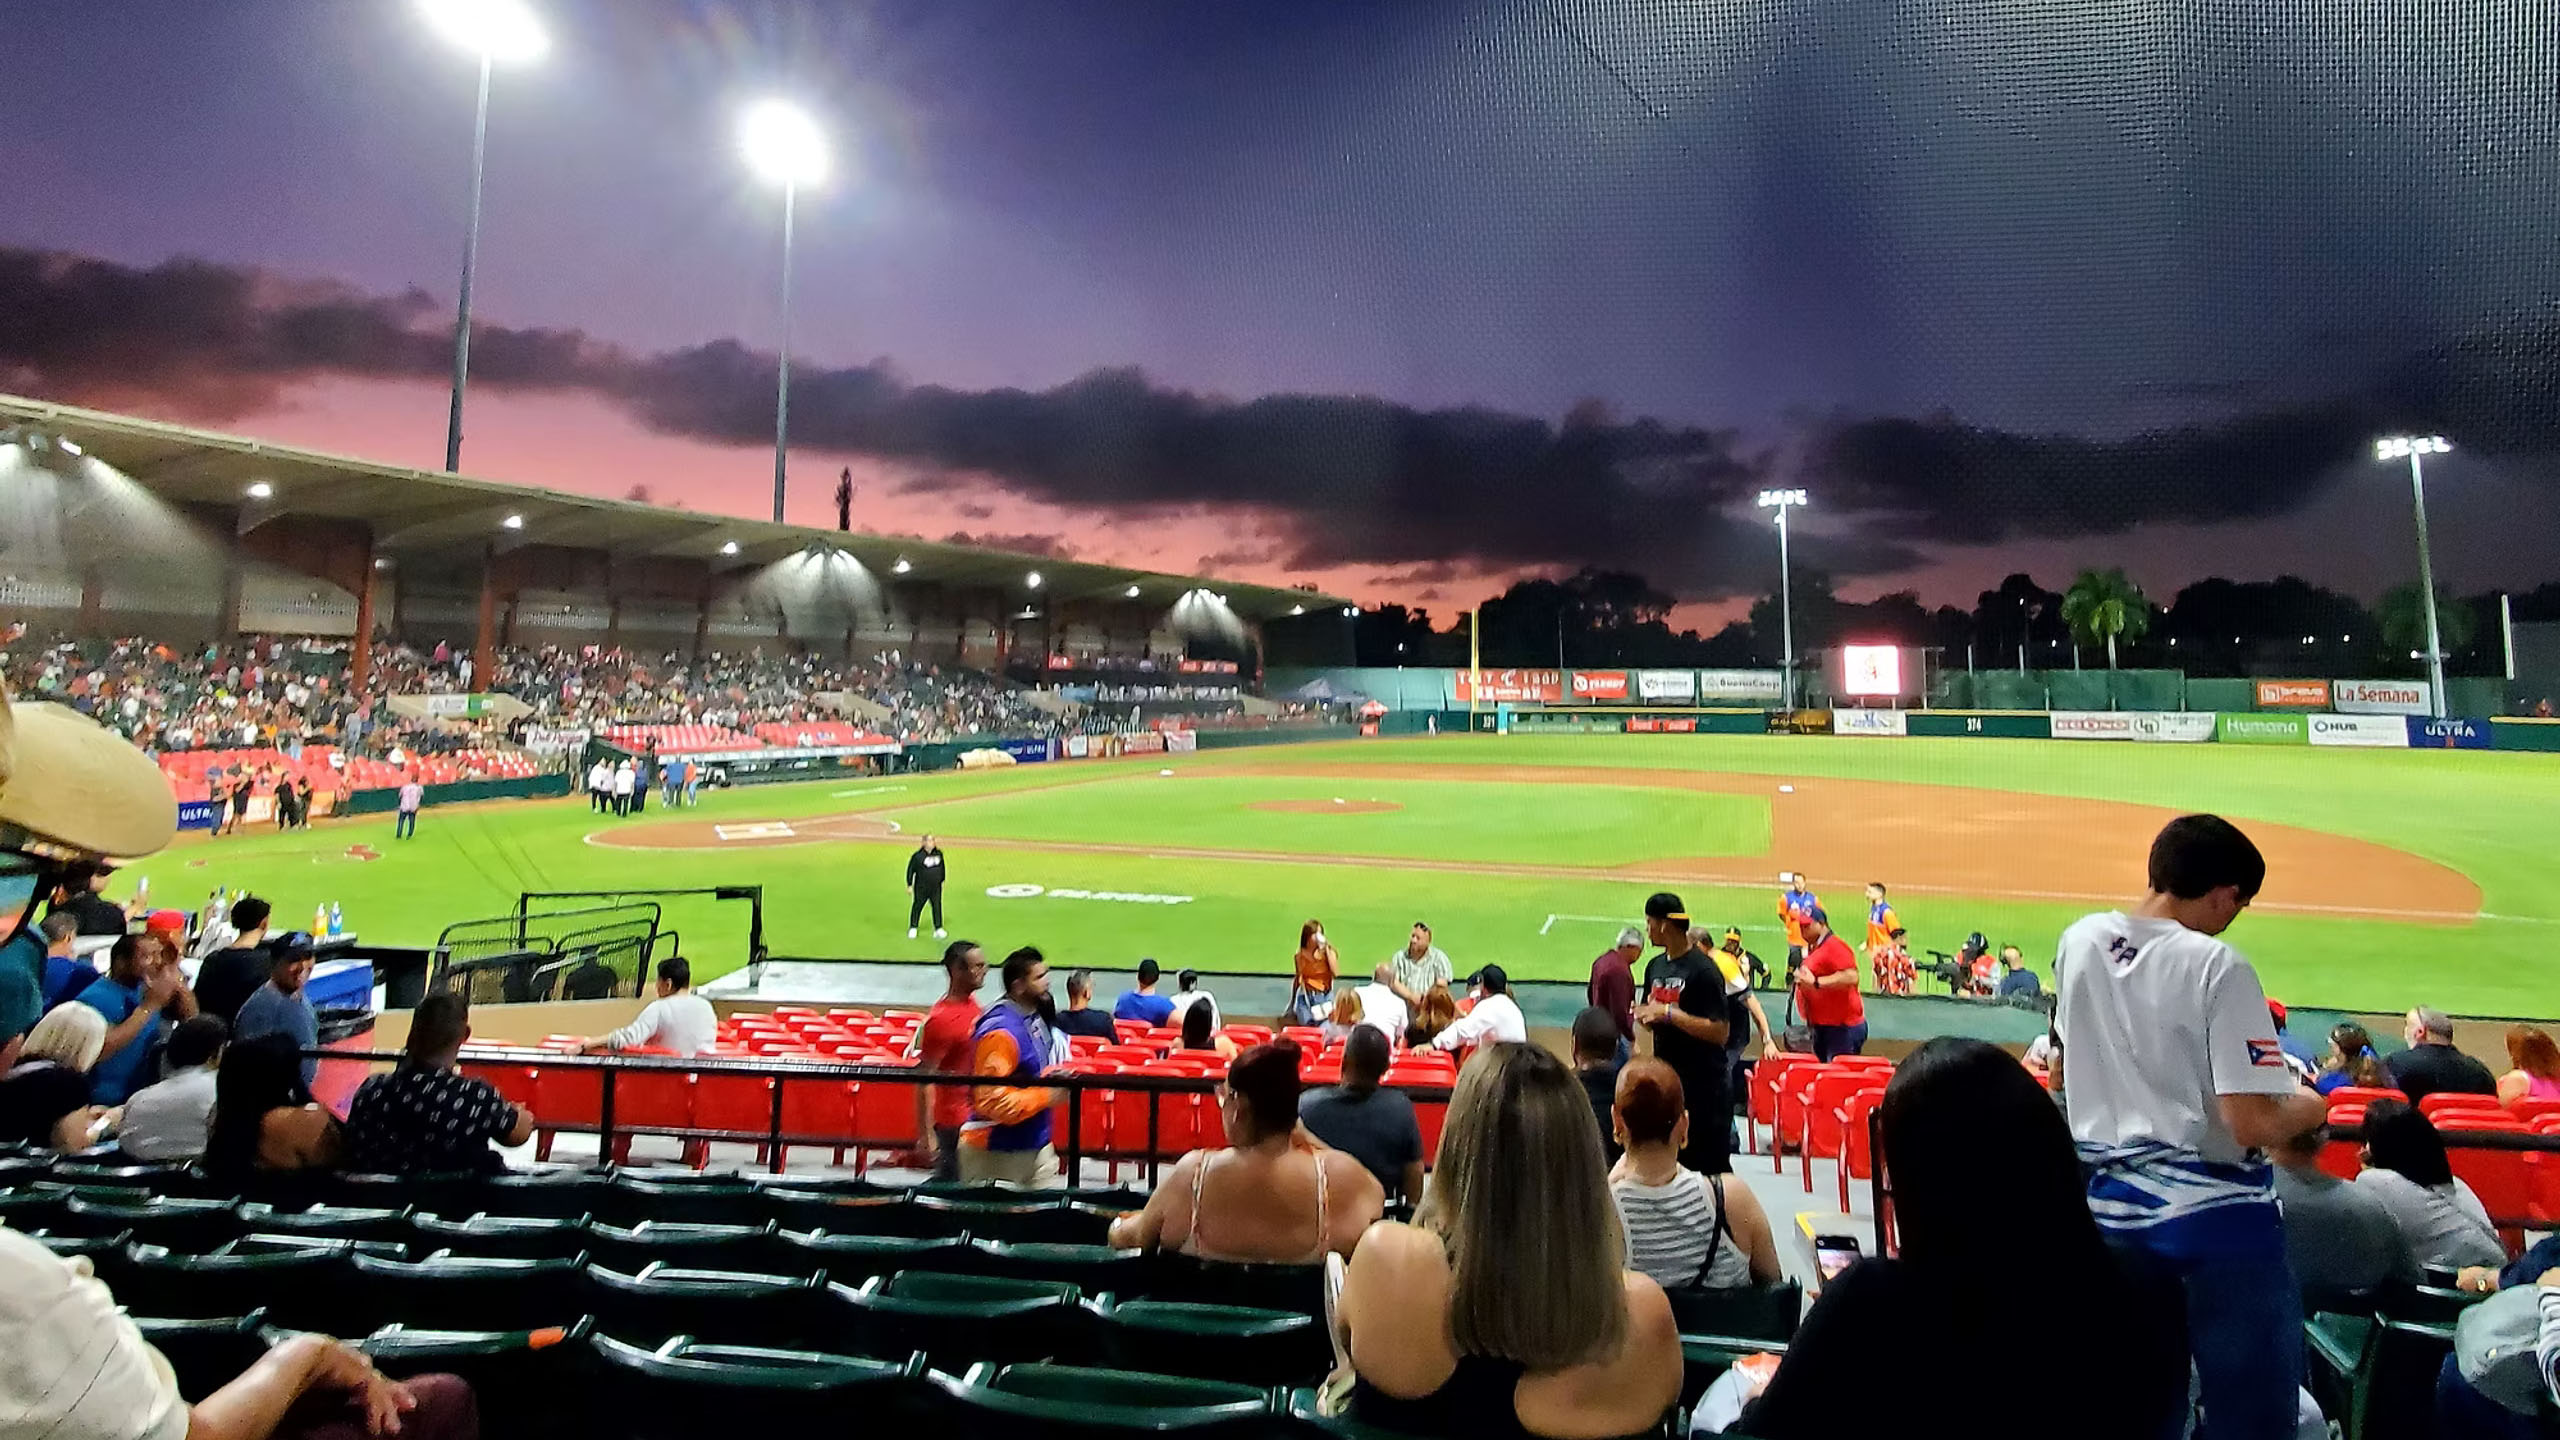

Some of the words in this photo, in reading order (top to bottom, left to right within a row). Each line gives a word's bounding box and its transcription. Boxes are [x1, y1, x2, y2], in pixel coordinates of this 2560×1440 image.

[2336, 684, 2354, 702] La
[2358, 685, 2420, 704] Semana
[2226, 718, 2299, 736] Humana
[2330, 722, 2358, 731] HUB
[2425, 724, 2476, 738] ULTRA
